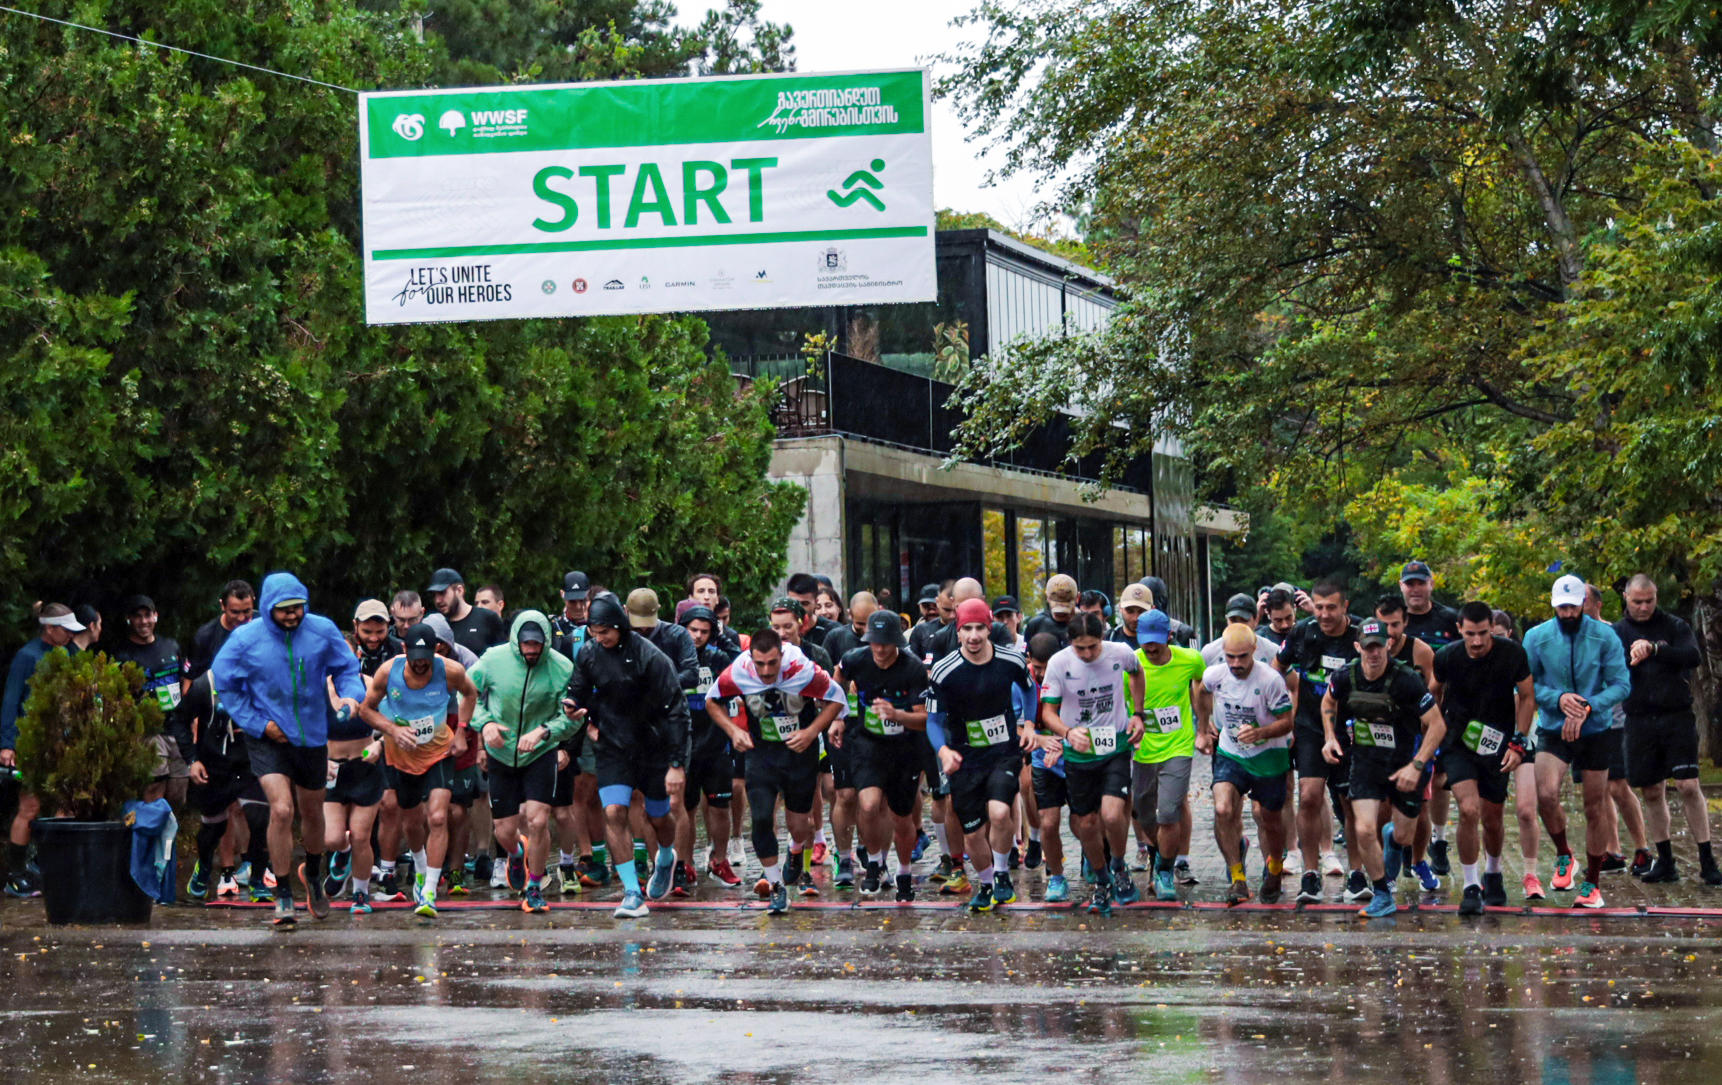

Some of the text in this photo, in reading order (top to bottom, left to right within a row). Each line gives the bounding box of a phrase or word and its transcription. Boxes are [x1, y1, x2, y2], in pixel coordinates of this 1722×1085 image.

[777, 87, 881, 109] გავერთიანდეთ
[471, 109, 528, 126] WWSF
[800, 105, 899, 127] გმირებისთვის
[532, 157, 778, 232] START
[410, 265, 491, 286] LET'S UNITE
[392, 279, 512, 307] for OUR HEROES
[1160, 715, 1178, 726] 034
[415, 725, 433, 737] 046
[779, 723, 797, 734] 057
[987, 725, 1005, 738] 017
[1094, 737, 1114, 747] 043
[1374, 732, 1393, 742] 059
[1480, 736, 1499, 750] 025
